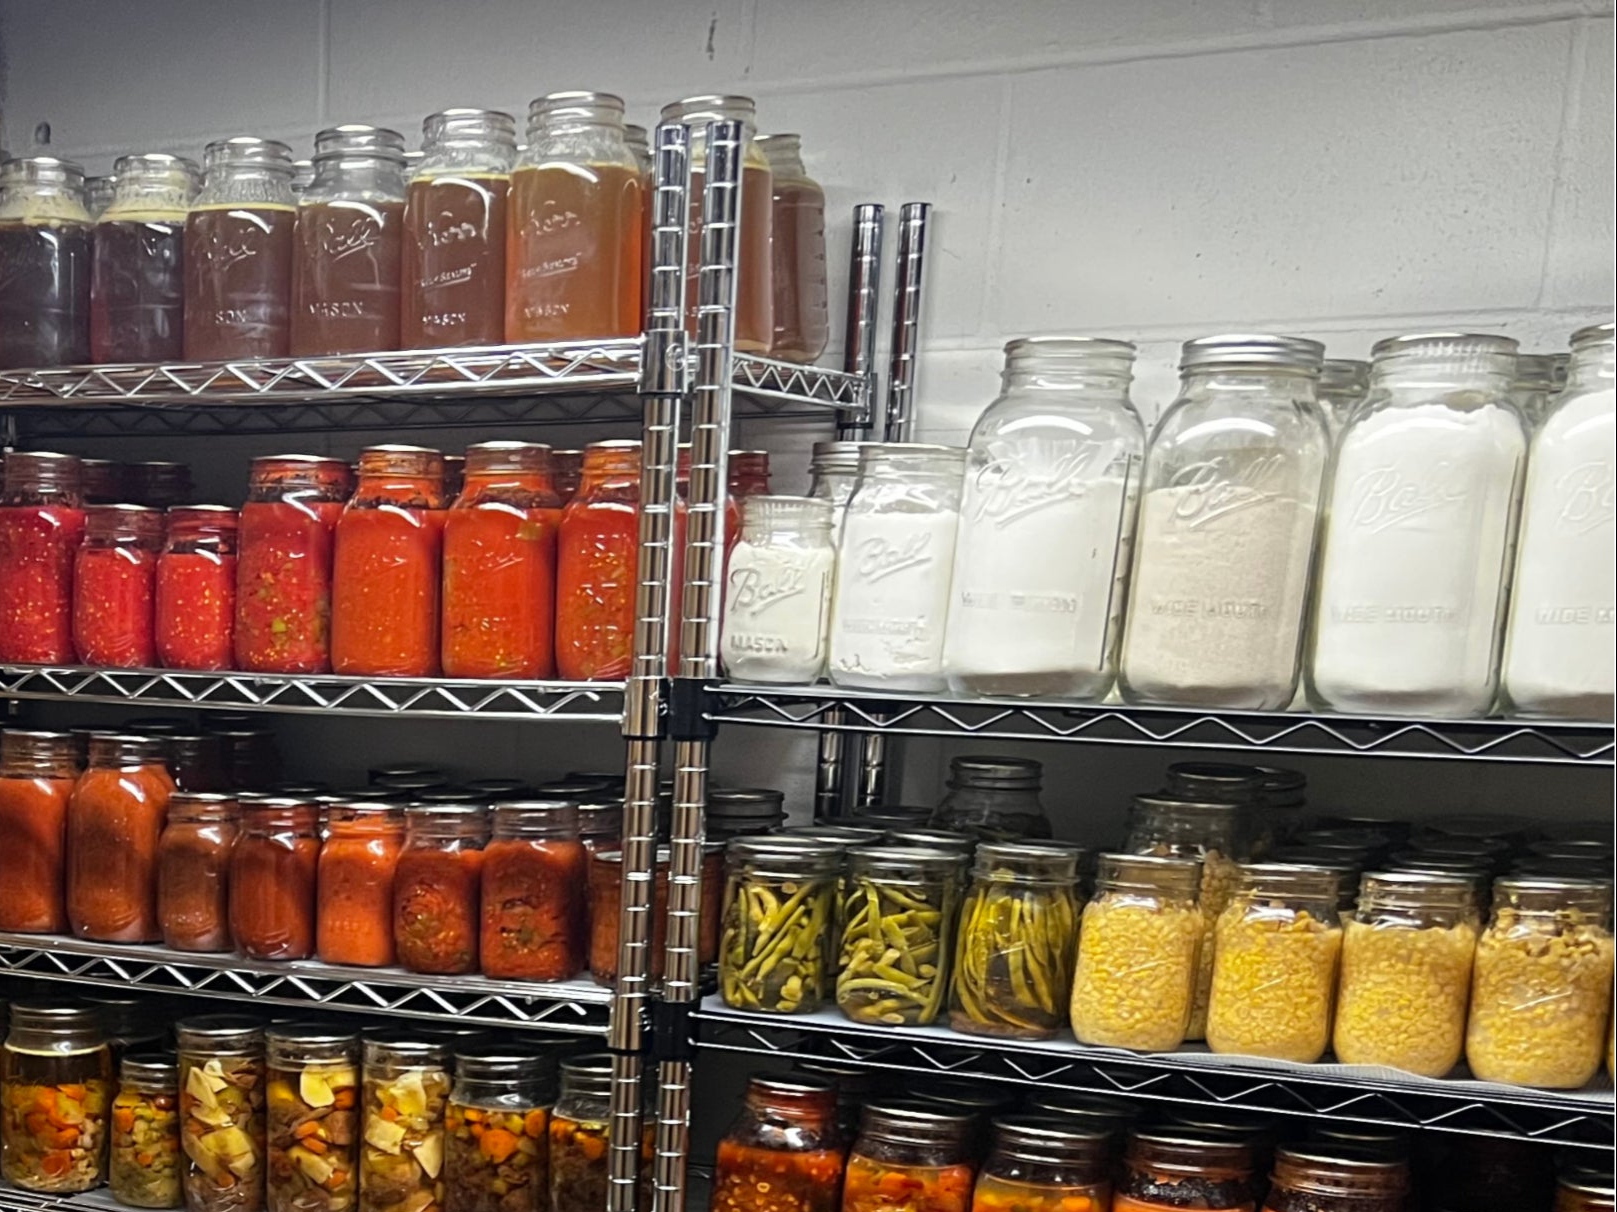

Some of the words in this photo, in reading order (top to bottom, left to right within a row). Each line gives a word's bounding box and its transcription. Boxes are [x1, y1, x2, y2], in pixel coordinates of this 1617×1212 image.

[1168, 453, 1290, 530] Ball
[854, 531, 932, 585] Ball
[729, 565, 809, 617] Ball
[1535, 606, 1591, 625] WIDE
[729, 633, 790, 654] MASON
